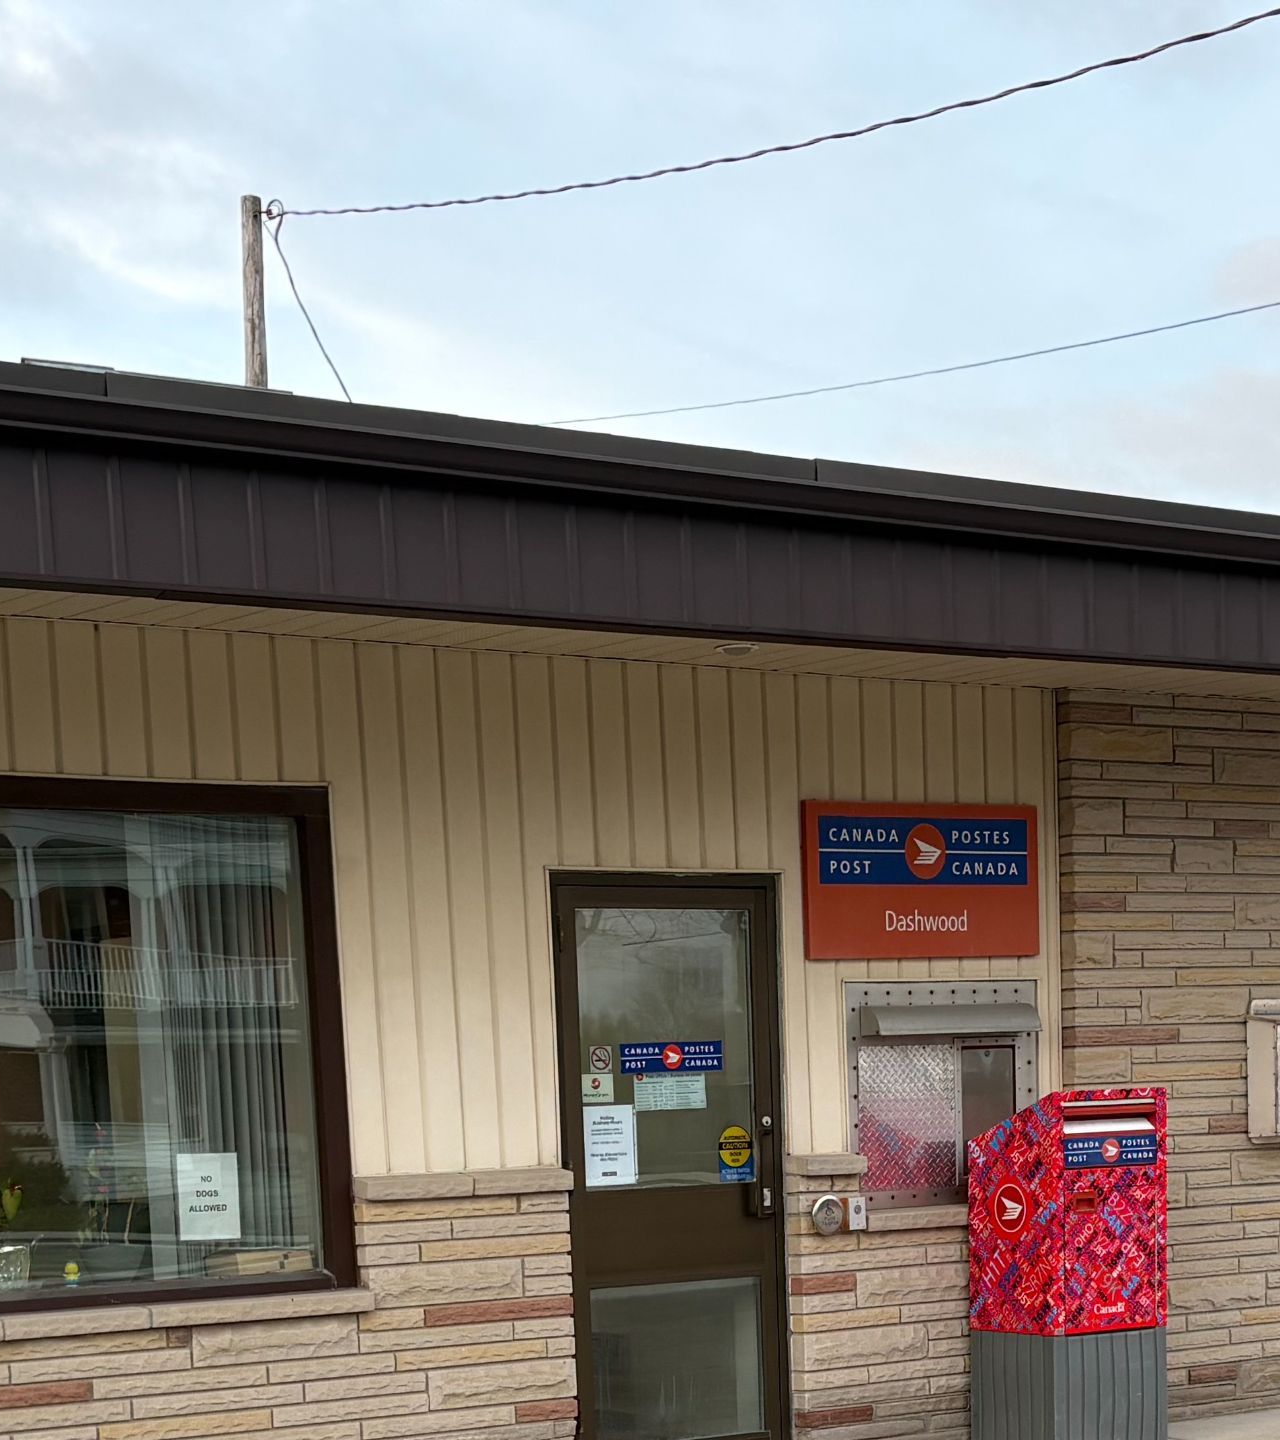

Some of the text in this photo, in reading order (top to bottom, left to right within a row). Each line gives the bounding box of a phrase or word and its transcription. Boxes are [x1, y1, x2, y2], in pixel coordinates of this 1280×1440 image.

[829, 827, 899, 843] CANADA
[952, 830, 1010, 845] POSTES
[830, 860, 871, 874] POST
[952, 861, 1018, 876] CANADA
[885, 910, 968, 932] Dashwood
[624, 1047, 660, 1055] CANADA
[684, 1045, 714, 1053] POSTES
[625, 1061, 646, 1069] POST
[685, 1058, 719, 1067] CANADA
[1068, 1141, 1100, 1149] CANADA
[1068, 1154, 1087, 1162] POST
[1122, 1151, 1153, 1159] CANADA
[200, 1175, 212, 1183] NO
[196, 1190, 219, 1198] DOGS
[188, 1203, 227, 1213] ALLOWED
[1094, 1302, 1125, 1314] Canada
